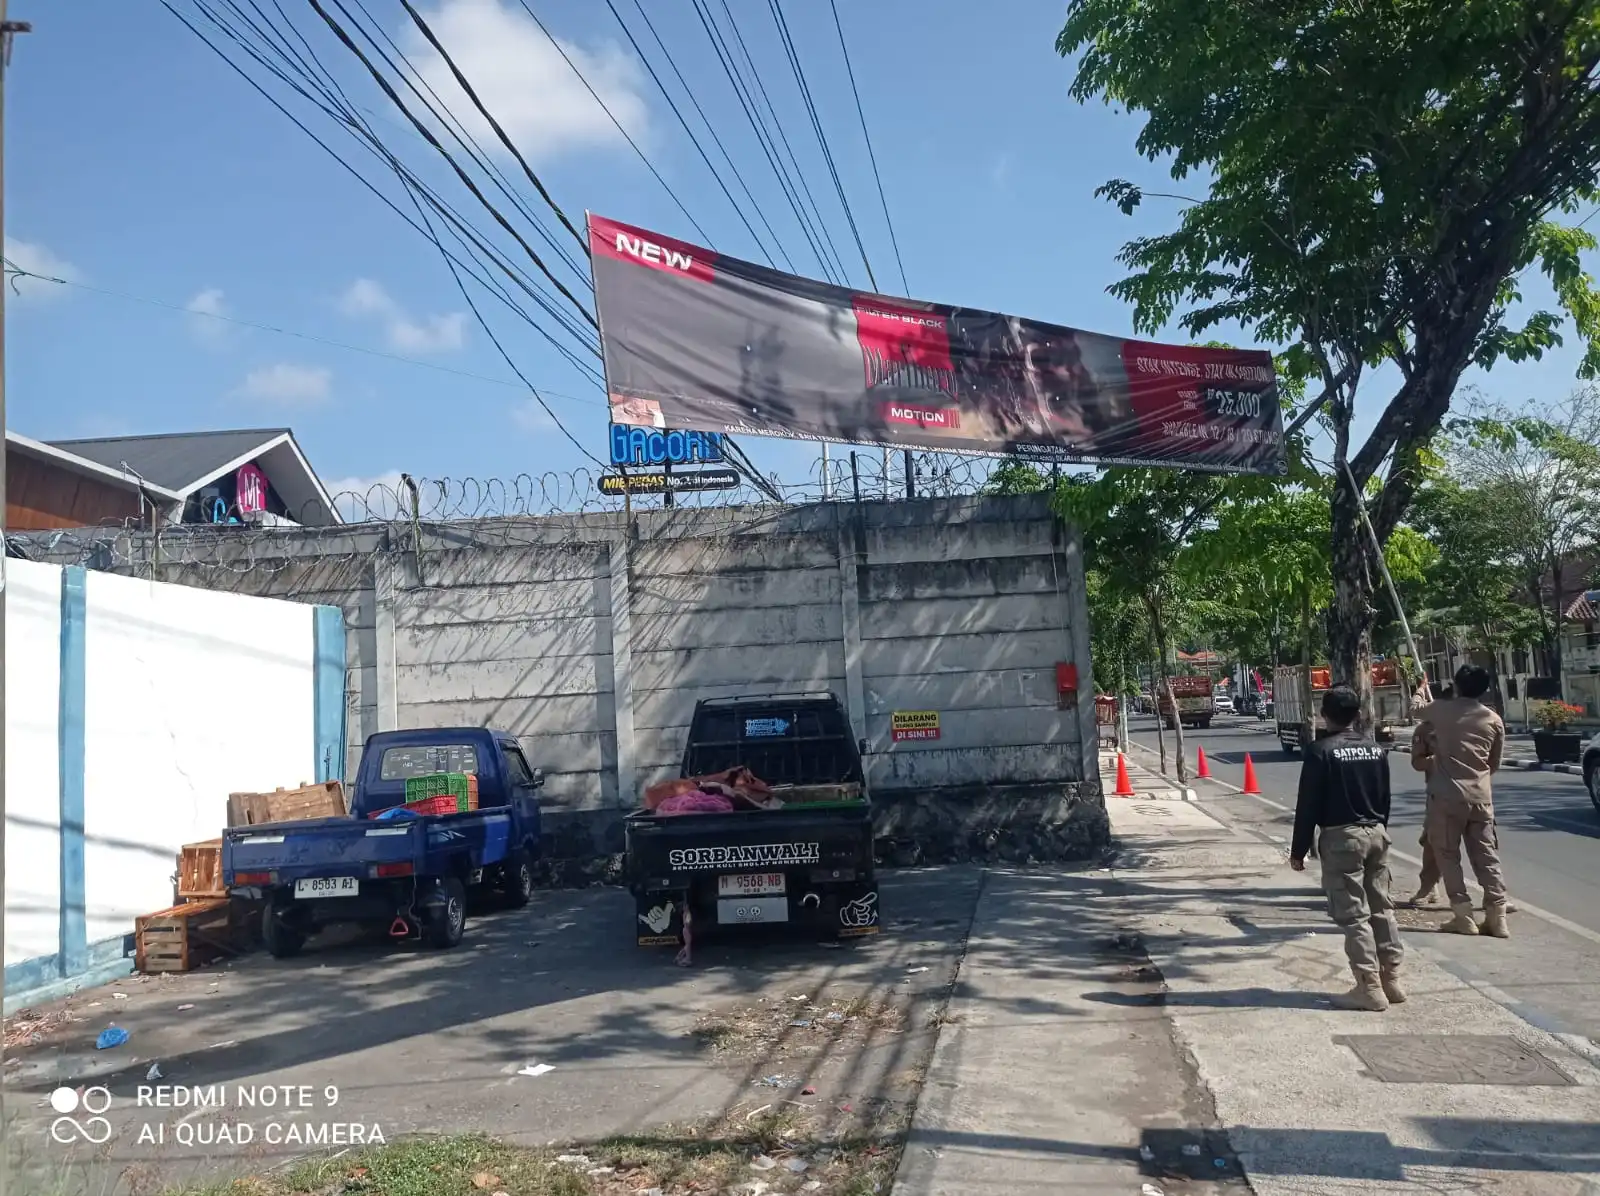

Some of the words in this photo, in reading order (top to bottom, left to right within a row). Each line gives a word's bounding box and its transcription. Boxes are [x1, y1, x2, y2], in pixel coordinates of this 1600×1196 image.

[616, 233, 692, 270] NEW
[901, 315, 942, 328] BLACK
[1137, 356, 1161, 374] STAY
[1204, 363, 1224, 379] STAY
[891, 407, 945, 422] MOTION
[603, 478, 625, 489] MIE
[701, 475, 734, 484] Indonesia
[894, 714, 937, 722] DILARANG
[897, 731, 906, 739] DI
[908, 730, 926, 738] SINI
[1333, 747, 1370, 758] SATPOL
[1371, 747, 1382, 755] PP
[670, 843, 819, 865] SORBANWALI
[298, 879, 305, 891] L
[312, 879, 337, 891] 8583
